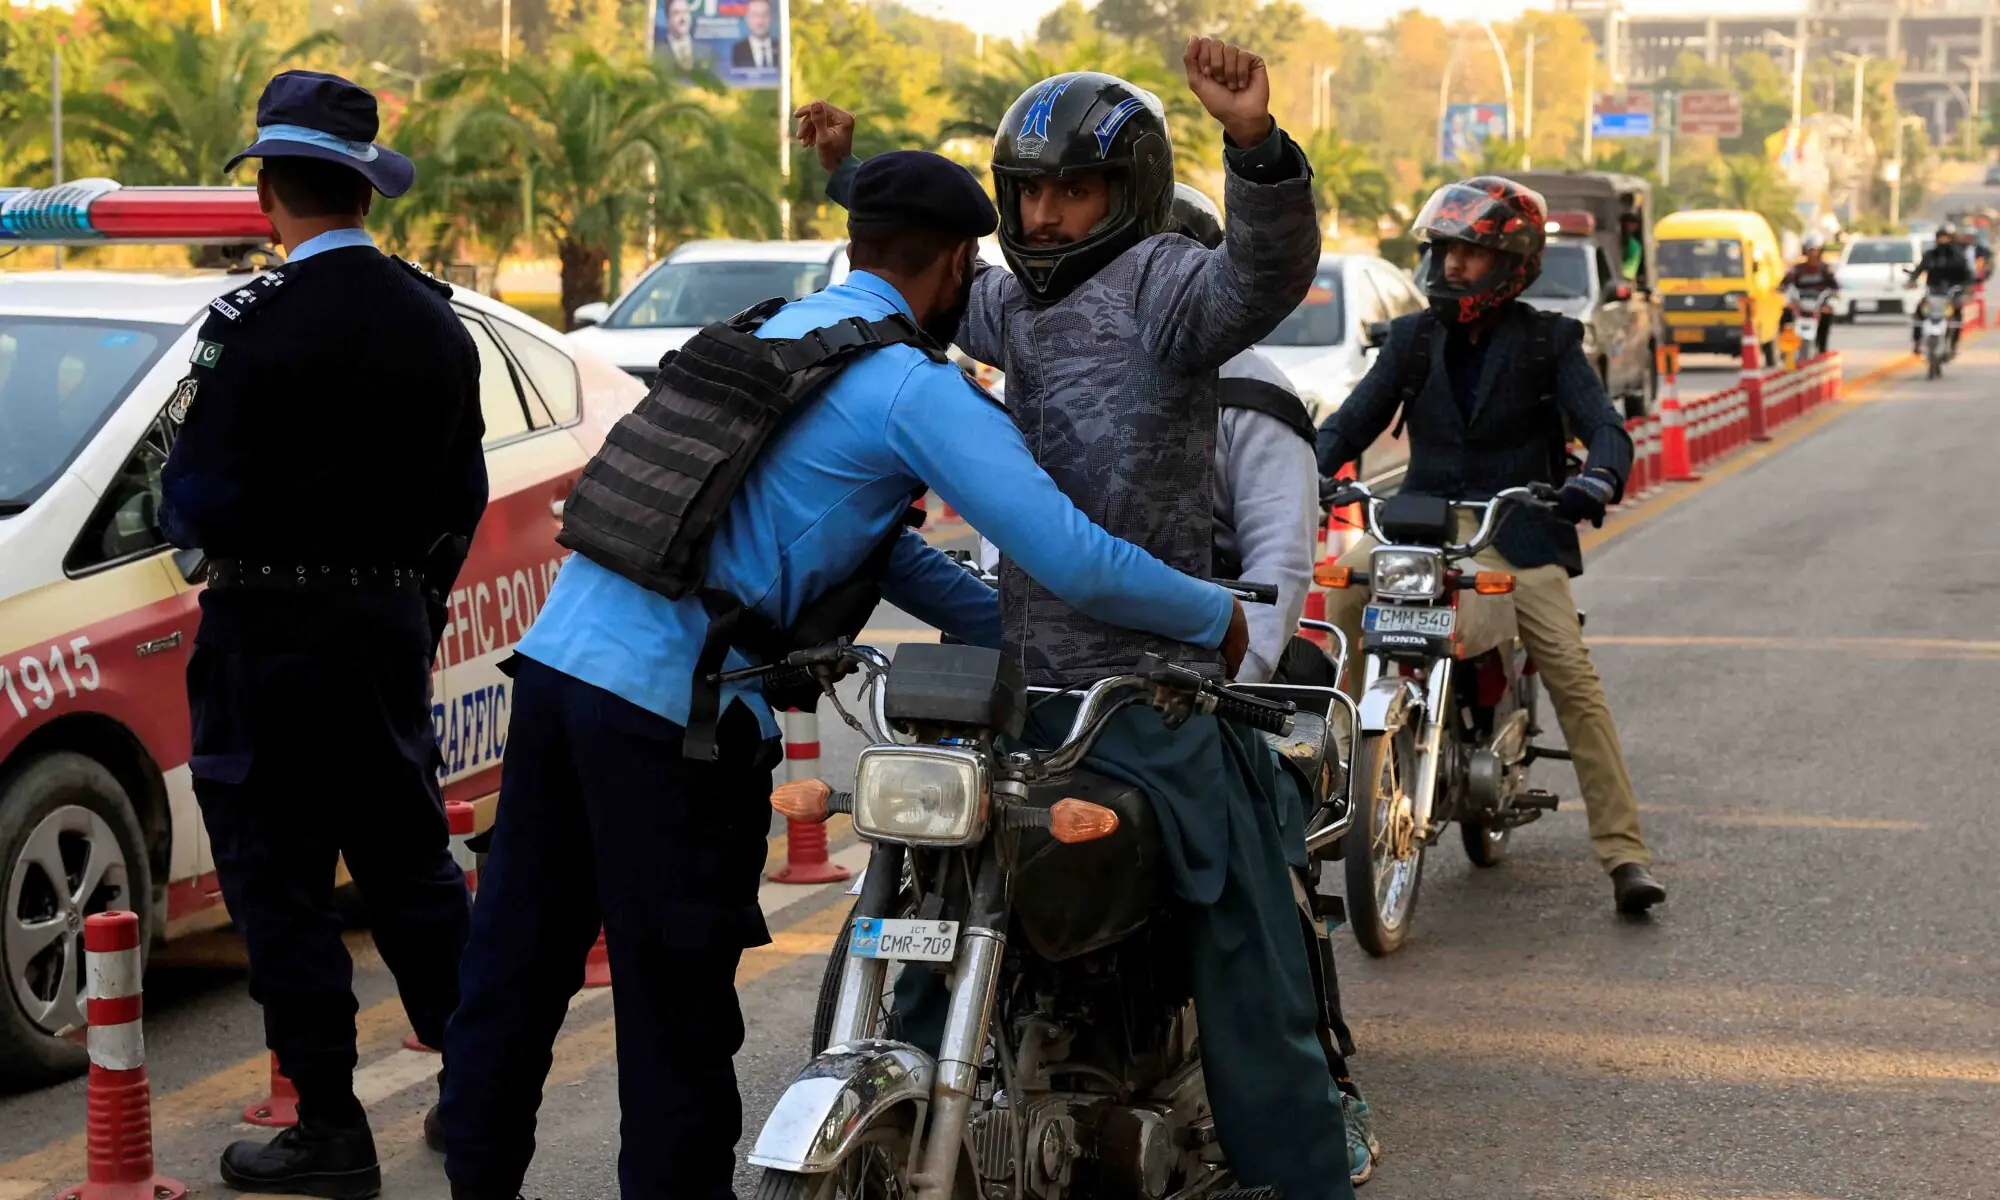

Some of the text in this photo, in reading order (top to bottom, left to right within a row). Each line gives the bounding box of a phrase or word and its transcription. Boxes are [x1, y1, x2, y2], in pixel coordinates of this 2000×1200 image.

[211, 296, 241, 320] POLICE
[1380, 608, 1450, 627] CMM 540
[1381, 635, 1428, 645] HONDA
[910, 926, 927, 934] ICT
[880, 935, 952, 956] CMR-709
